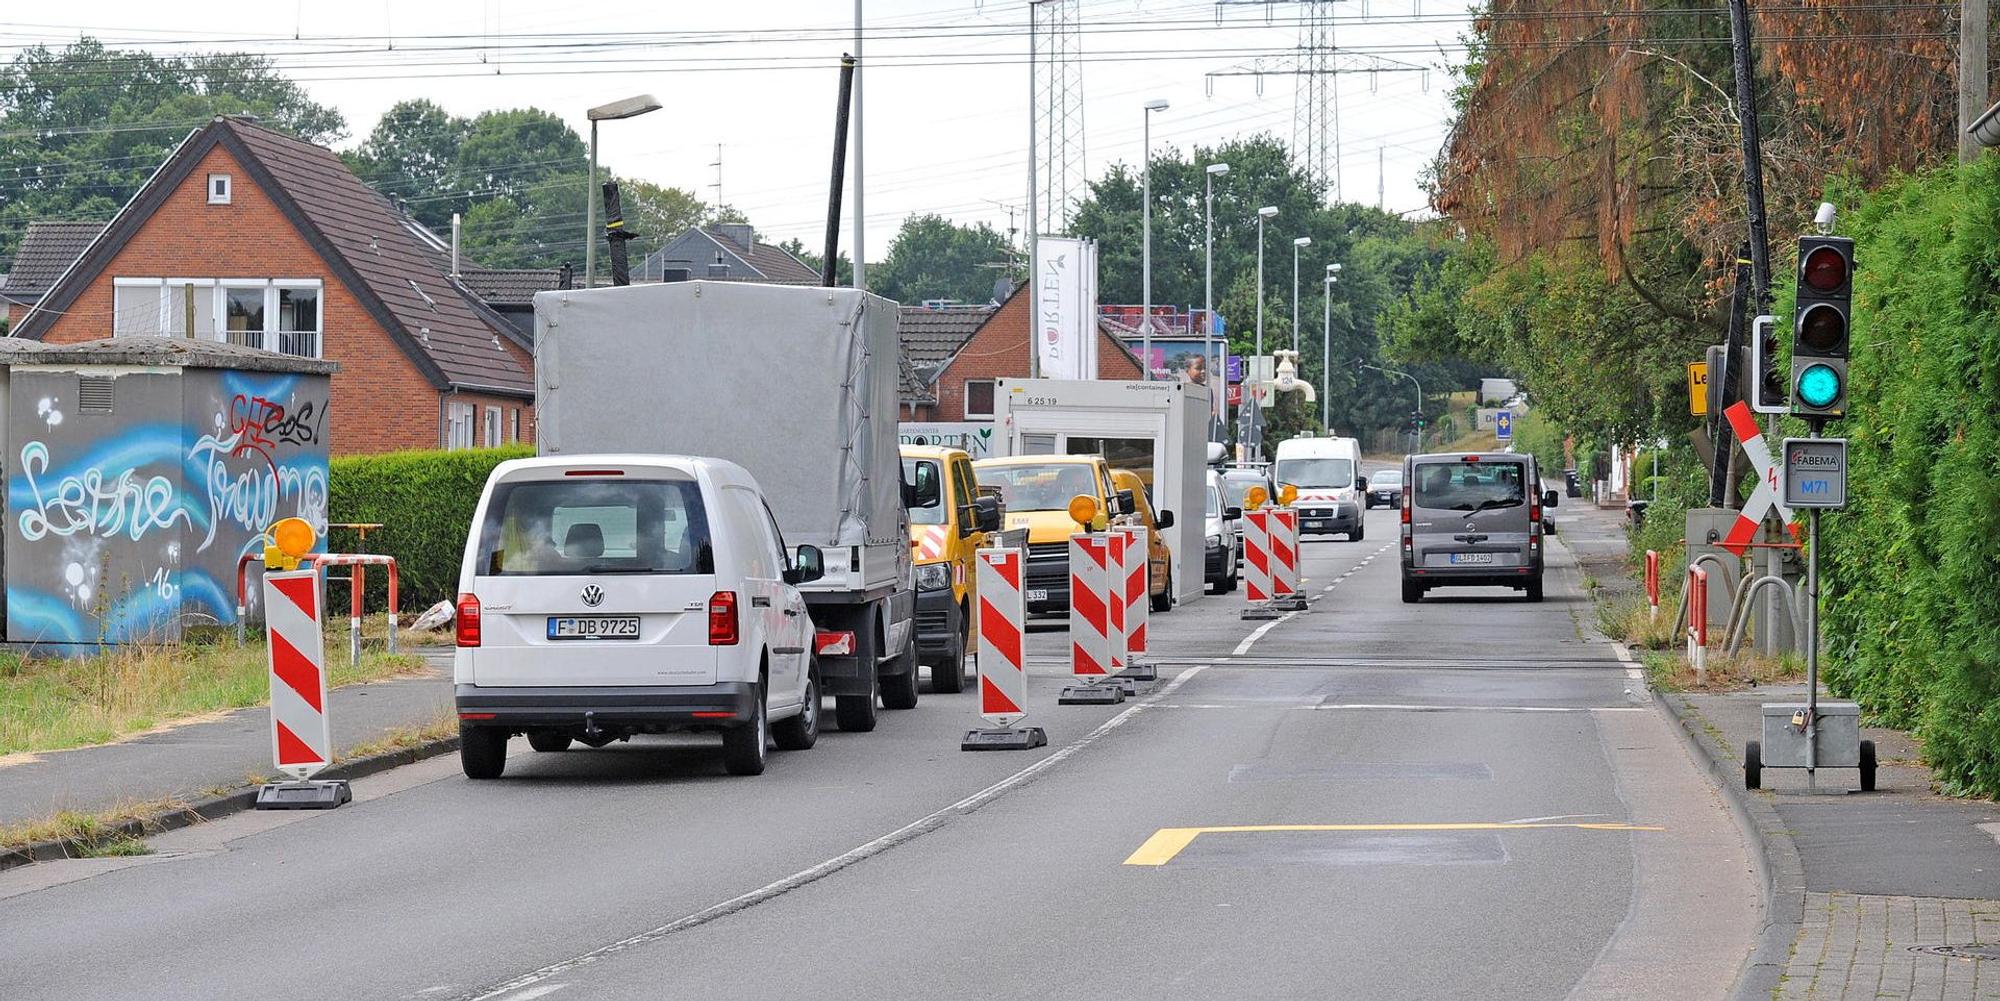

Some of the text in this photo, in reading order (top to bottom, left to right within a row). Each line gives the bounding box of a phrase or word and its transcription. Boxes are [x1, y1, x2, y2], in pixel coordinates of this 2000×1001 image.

[1027, 397, 1057, 405] 6 25 19
[1797, 456, 1837, 466] FABEMA
[1802, 480, 1828, 494] M71
[558, 620, 637, 634] F DB 9725
